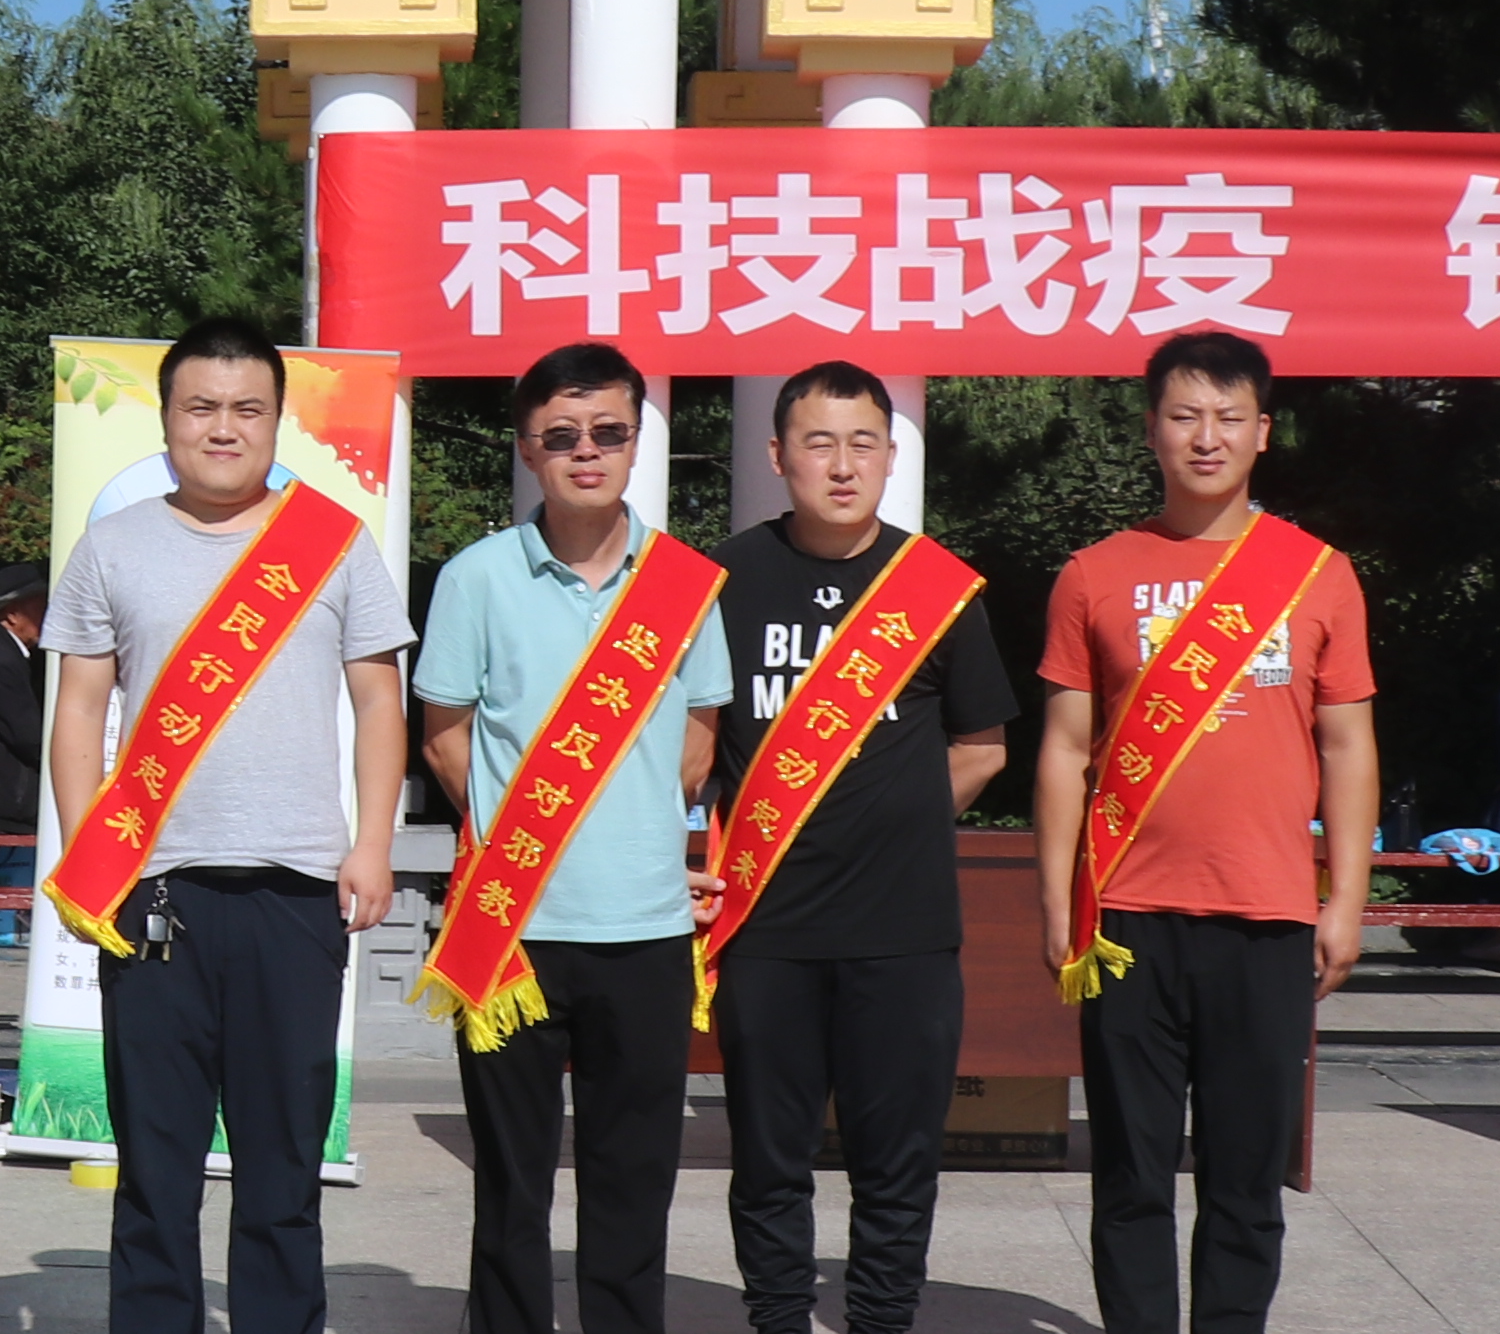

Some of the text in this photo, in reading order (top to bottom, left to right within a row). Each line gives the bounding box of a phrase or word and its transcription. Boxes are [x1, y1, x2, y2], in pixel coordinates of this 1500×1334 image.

[441, 173, 1292, 335] 科技战疫
[105, 561, 301, 849] 全民行动起来
[476, 622, 659, 927] 坚决反对邪教
[730, 609, 918, 890] 全民行动起来
[1091, 601, 1255, 861] 全民行动起
